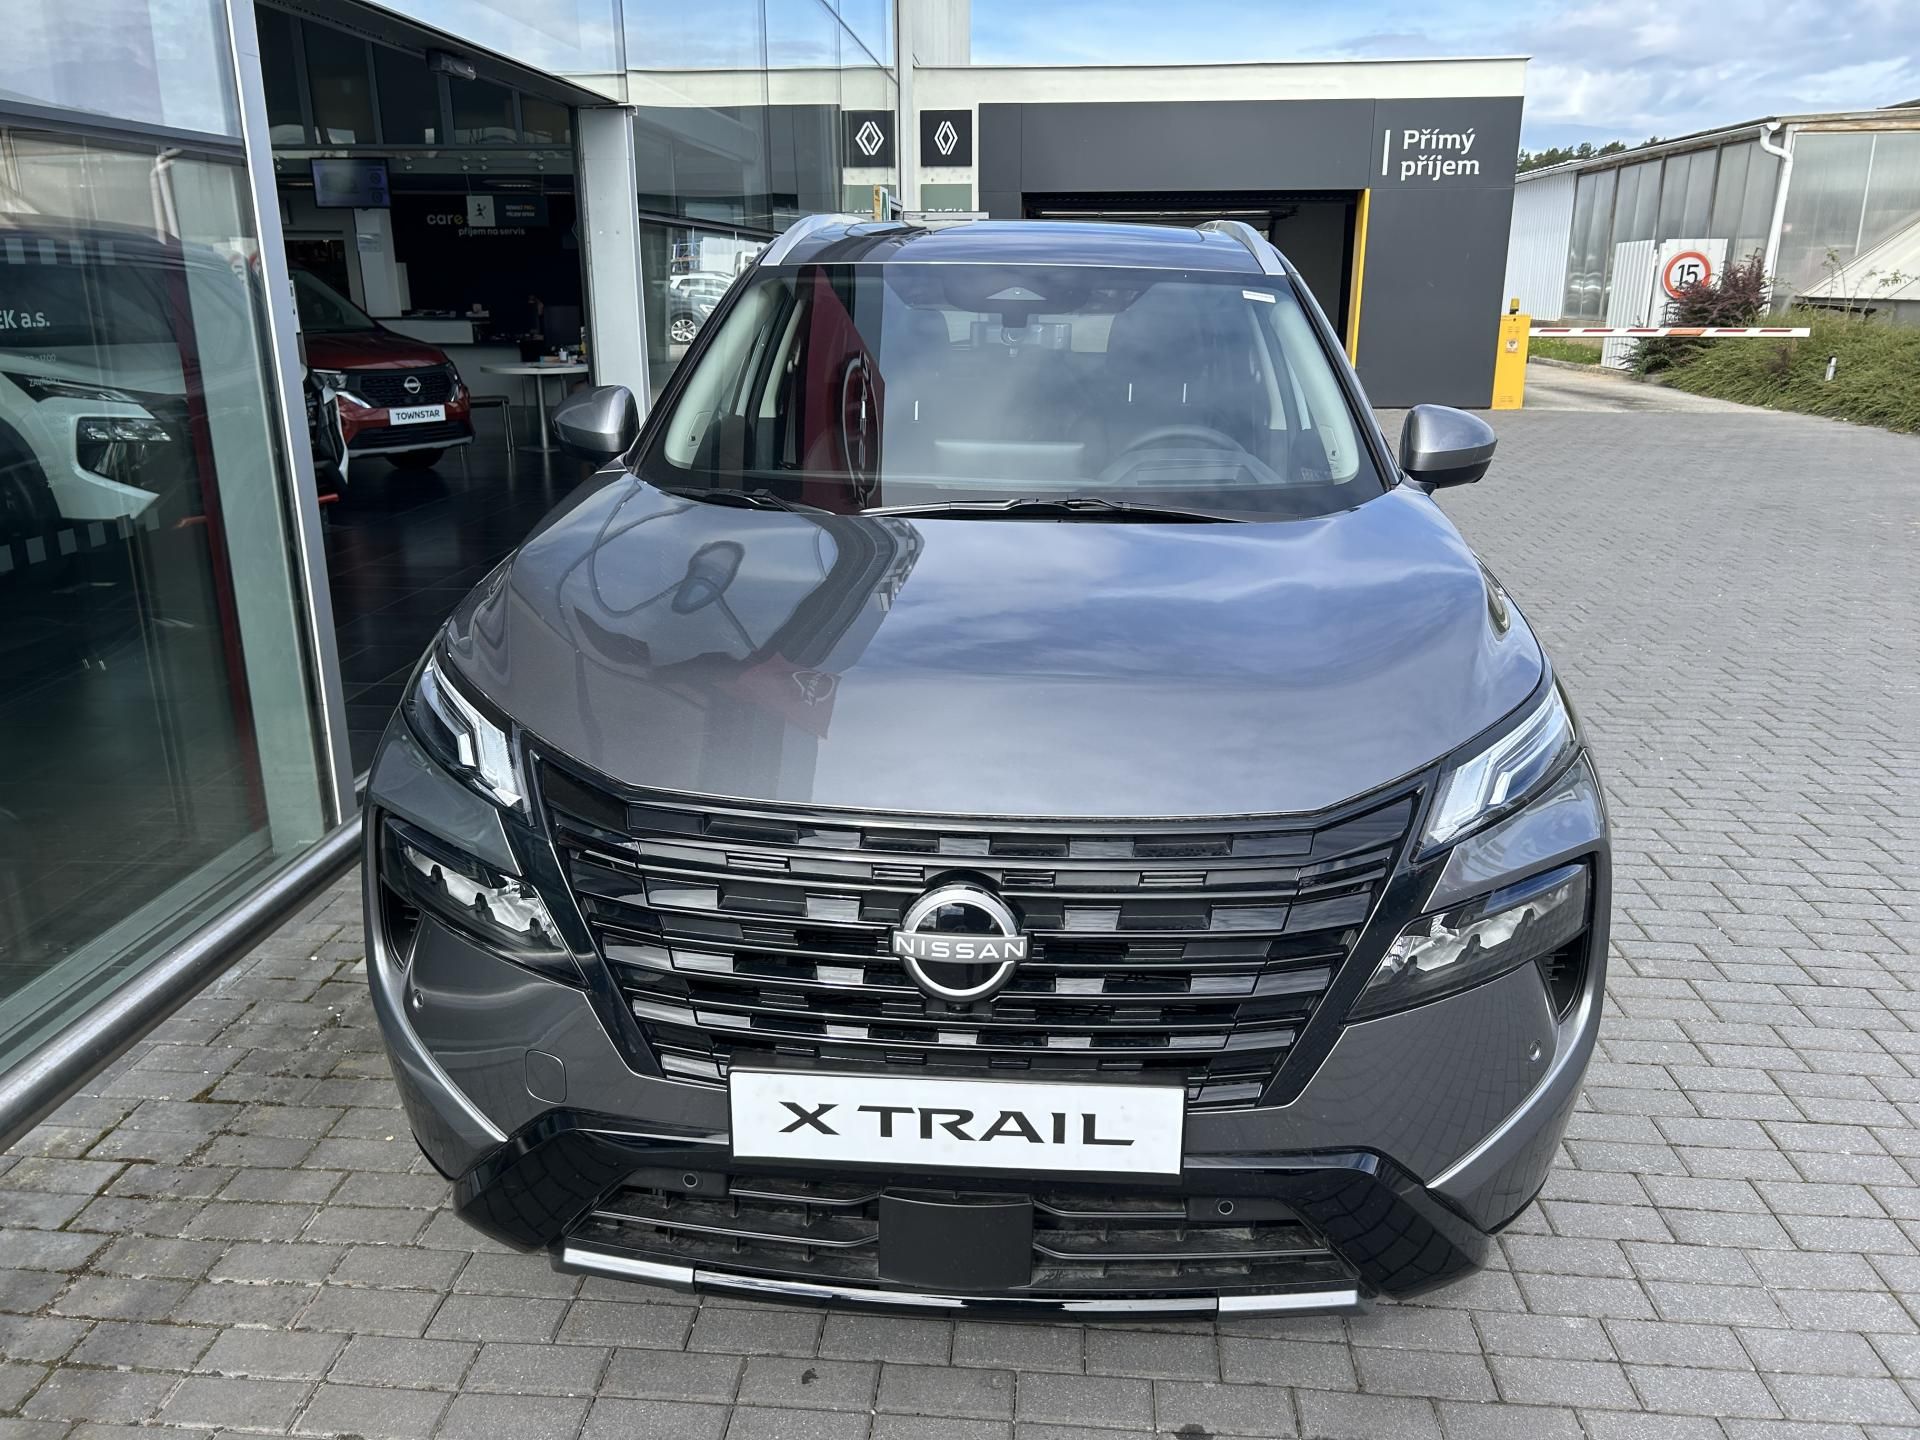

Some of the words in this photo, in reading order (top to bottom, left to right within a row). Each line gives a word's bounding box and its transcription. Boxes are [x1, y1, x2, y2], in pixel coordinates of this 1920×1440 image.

[1403, 128, 1476, 154] Přímý
[1400, 155, 1480, 181] příjem
[426, 214, 463, 225] care
[1678, 264, 1699, 287] 15
[20, 311, 51, 328] a.s.
[395, 409, 440, 421] TOWNSTAR
[895, 936, 1024, 959] NISSAN
[778, 1101, 840, 1135] X
[857, 1105, 1134, 1146] TRAIL
